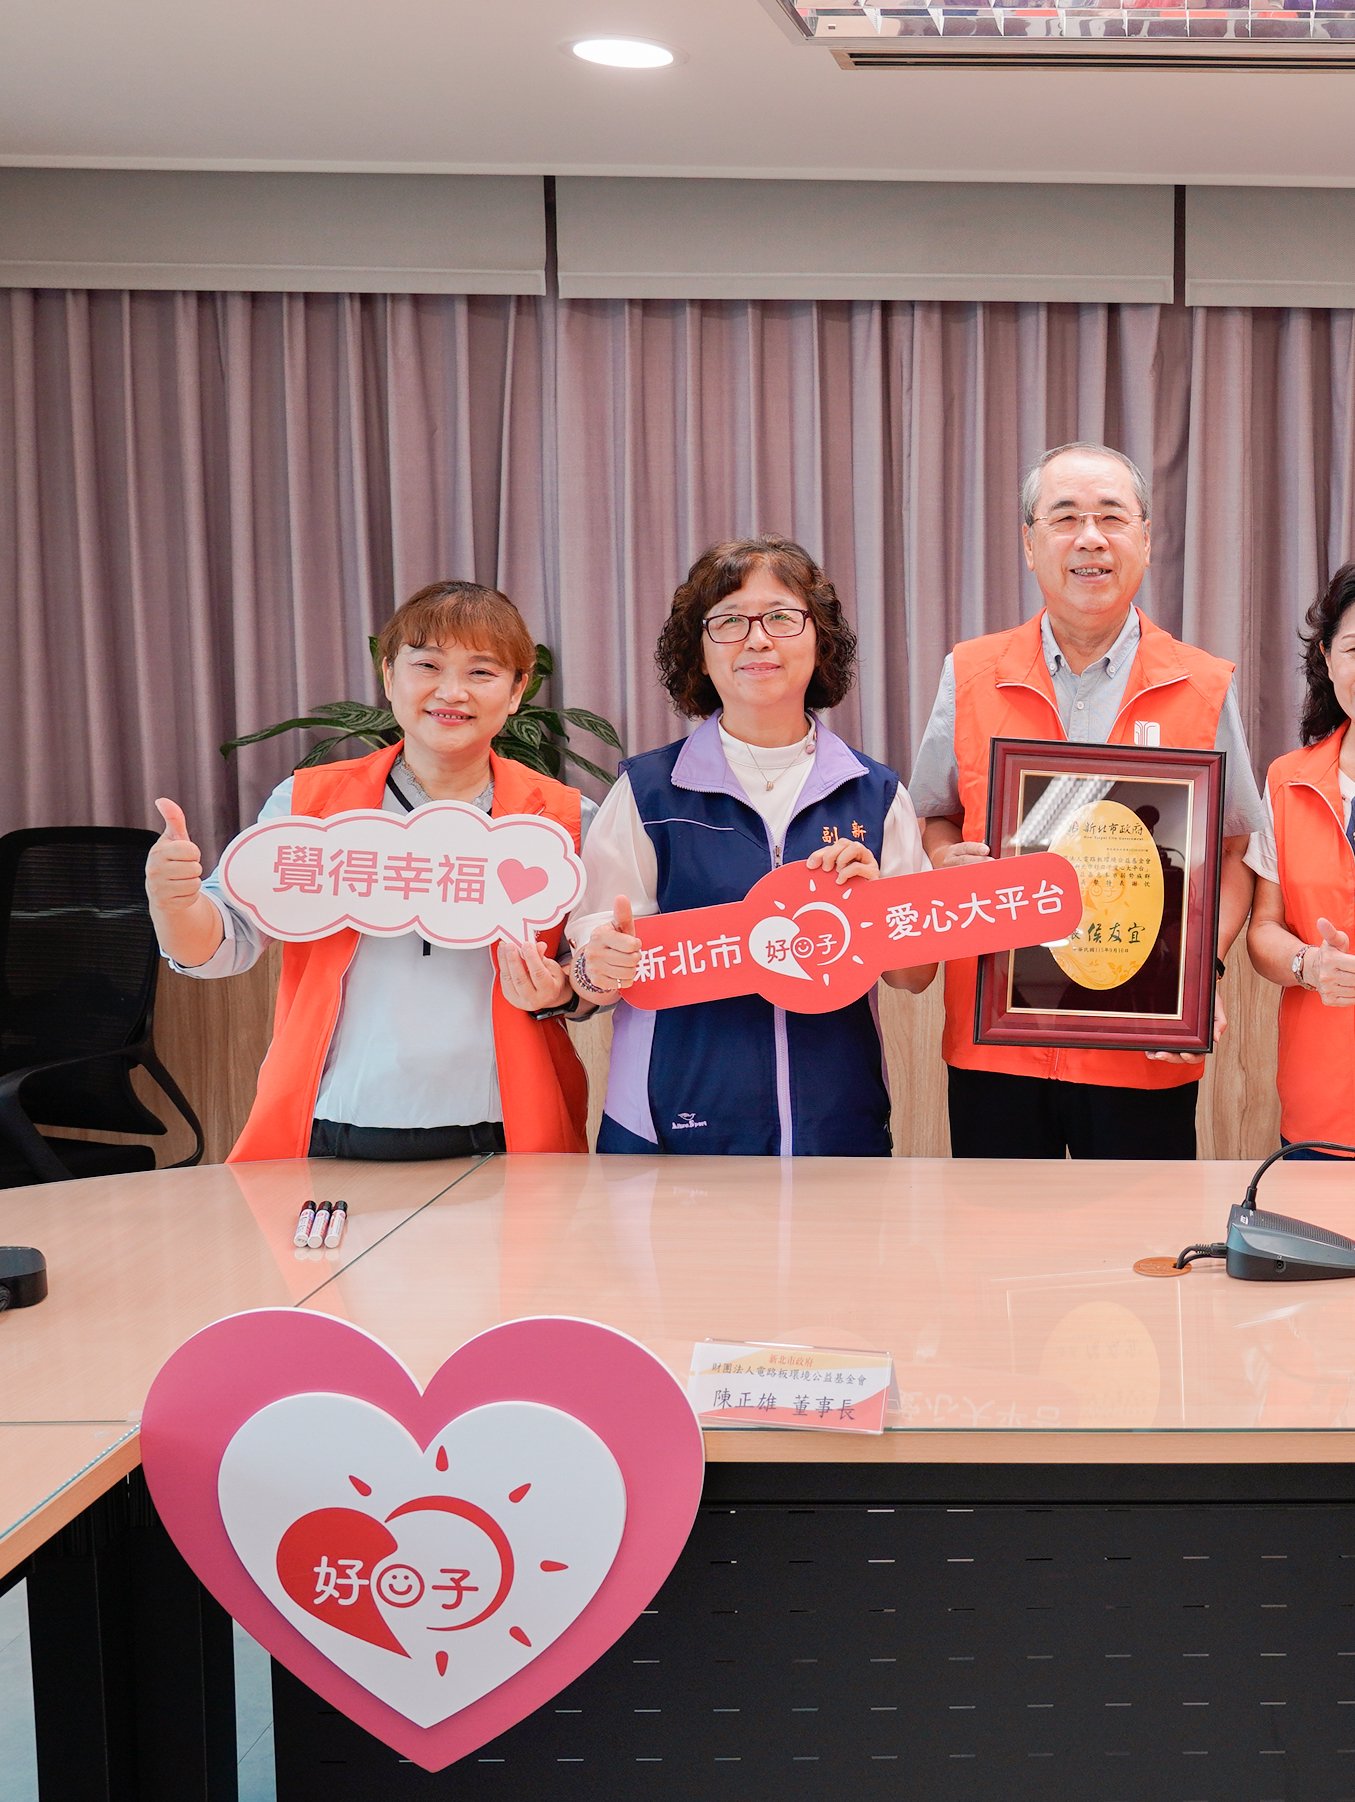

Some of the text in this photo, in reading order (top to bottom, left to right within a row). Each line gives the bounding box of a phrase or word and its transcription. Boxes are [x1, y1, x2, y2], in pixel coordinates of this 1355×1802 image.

[272, 844, 489, 906] 覺得幸福
[634, 933, 743, 983] 新北市
[885, 878, 1065, 942] 愛心大平台
[713, 1387, 856, 1421] 陳正雄 董事長
